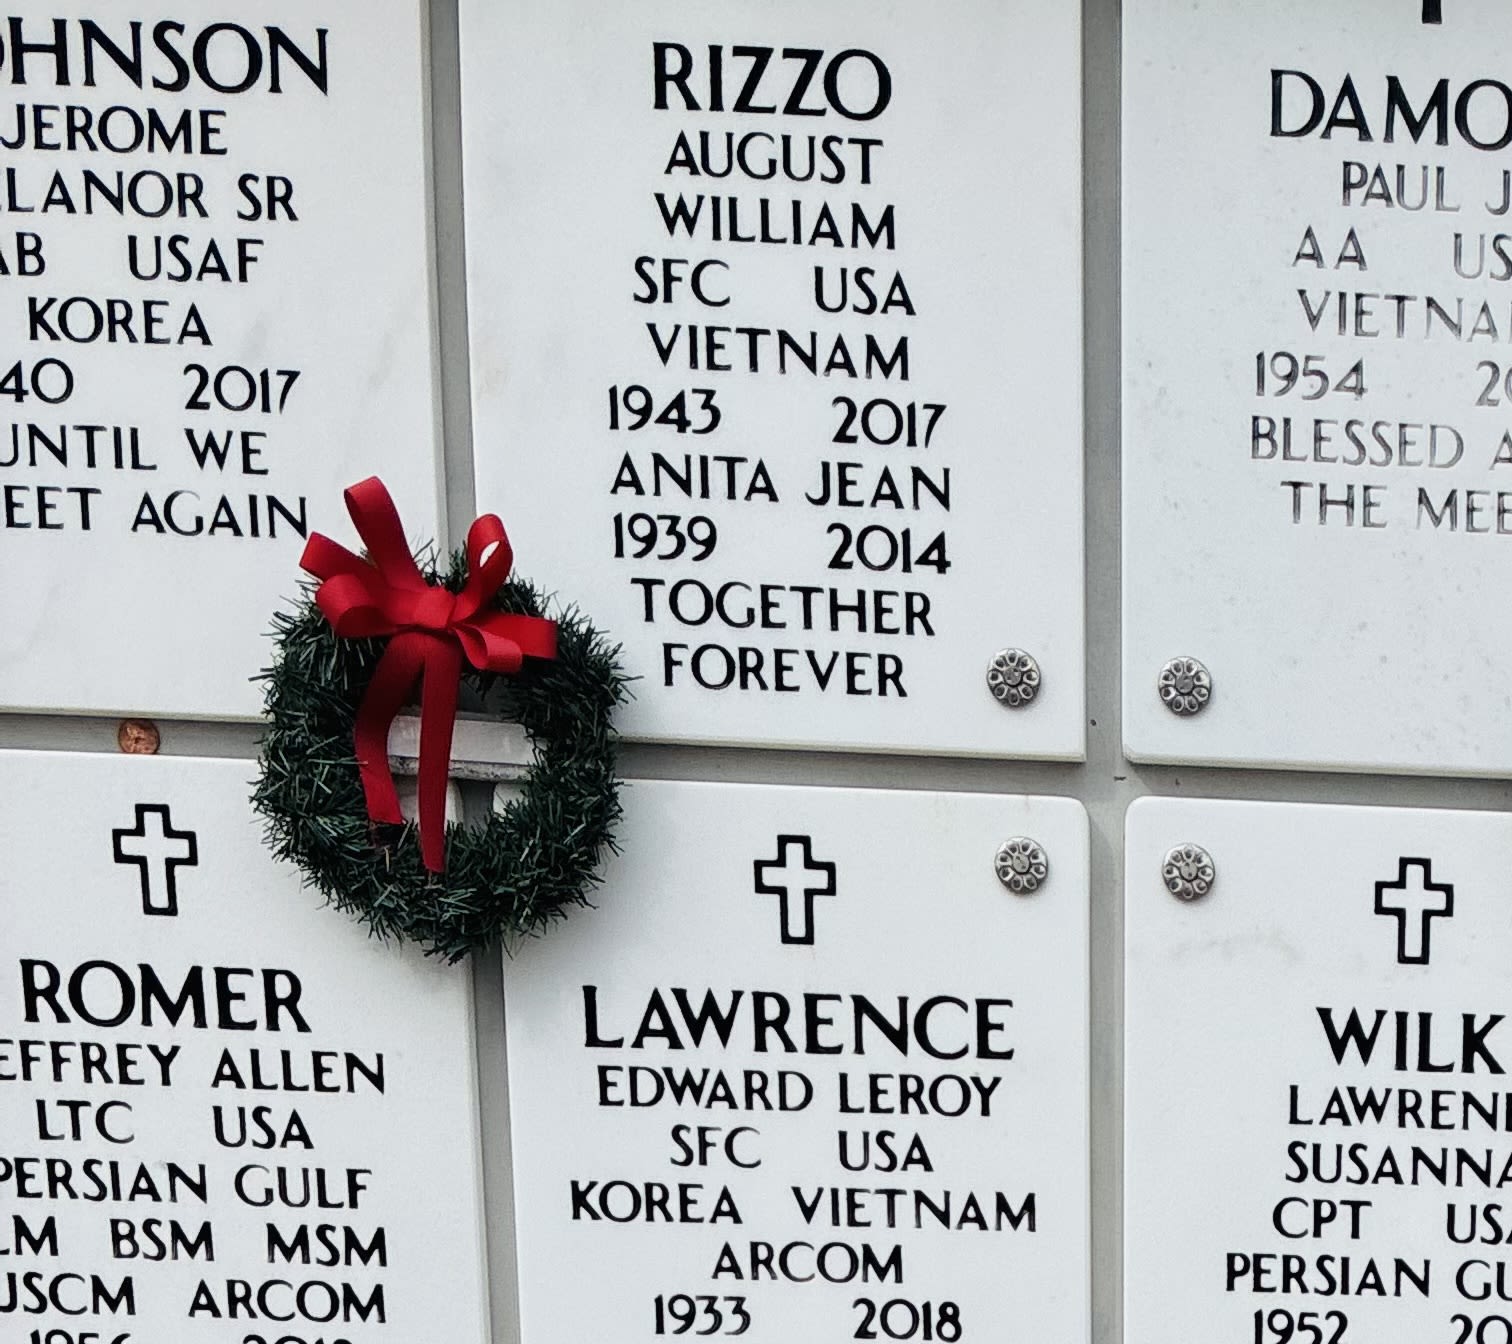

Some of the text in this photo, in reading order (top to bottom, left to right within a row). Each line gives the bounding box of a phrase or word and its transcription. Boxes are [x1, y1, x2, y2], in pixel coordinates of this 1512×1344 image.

[651, 41, 893, 123] RIZZO
[0, 102, 229, 157] JEROME
[653, 191, 896, 251] WILLIAM
[1291, 224, 1368, 272] AA
[632, 254, 917, 317] SFC USA
[27, 295, 214, 347] KOREA
[0, 422, 270, 477] UNTIL WE
[1250, 414, 1465, 469] BLESSED
[609, 450, 951, 513] ANITA JEAN
[629, 576, 936, 638] TOGETHER
[18, 957, 313, 1034] ROMER
[581, 984, 1016, 1062] LAWRENCE
[1314, 1005, 1507, 1076] WILK
[596, 1064, 1003, 1118] EDWARD LEROY
[34, 1098, 315, 1151] LTC USA
[571, 1179, 1037, 1234] KOREA VIETNAM
[1225, 1251, 1432, 1299] PERSIAN
